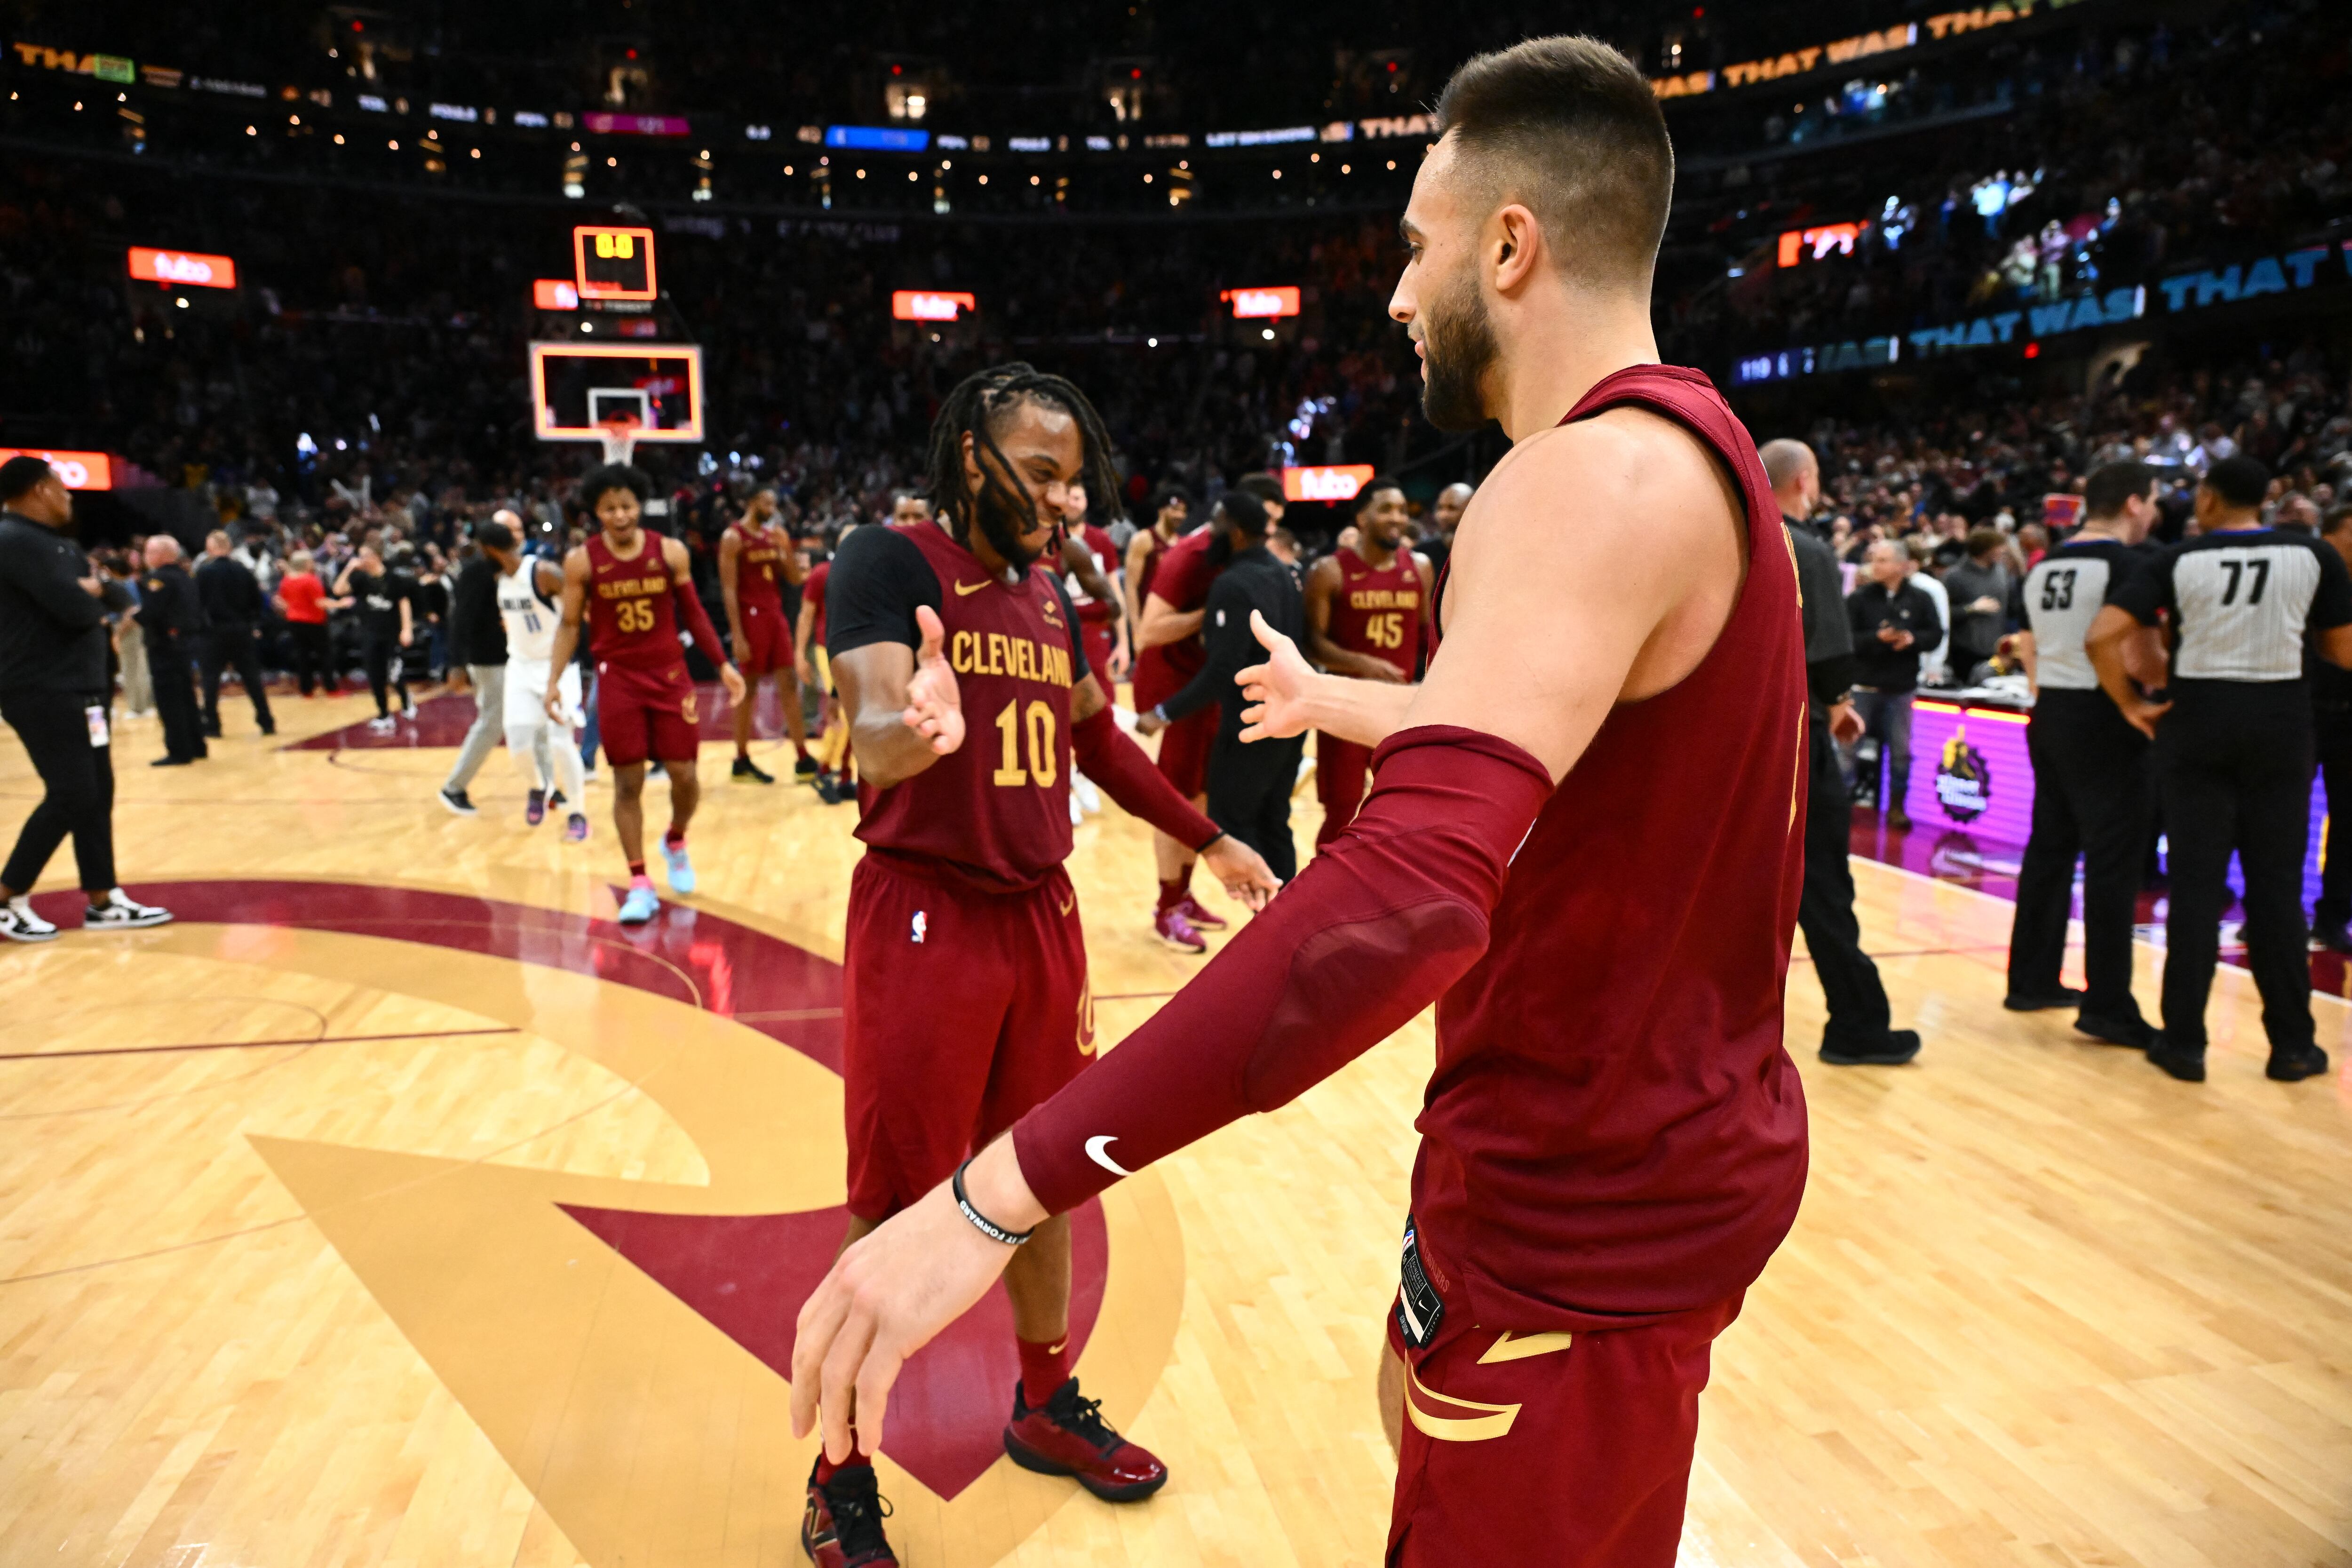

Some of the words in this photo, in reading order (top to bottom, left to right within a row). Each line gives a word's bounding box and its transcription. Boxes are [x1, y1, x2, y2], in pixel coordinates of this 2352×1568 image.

[1722, 45, 1821, 88] THAT
[1826, 23, 1908, 65] WAS
[154, 252, 213, 283] fubo
[2160, 250, 2329, 313] THAT
[1237, 291, 1283, 315] fubo
[1907, 311, 2022, 360] THAT
[2029, 288, 2136, 337] WAS
[1299, 469, 1358, 500] fubo
[598, 576, 667, 599] CLEVELAND
[2040, 569, 2077, 611] 53
[2220, 558, 2270, 606] 77
[616, 598, 654, 633] 35
[1350, 589, 1419, 610] CLEVELAND
[524, 613, 541, 633] 11
[1366, 613, 1403, 650] 45
[993, 698, 1057, 788] 10
[1411, 1258, 1424, 1287] ENGINEERED
[1424, 1321, 1436, 1343] LENGTH
